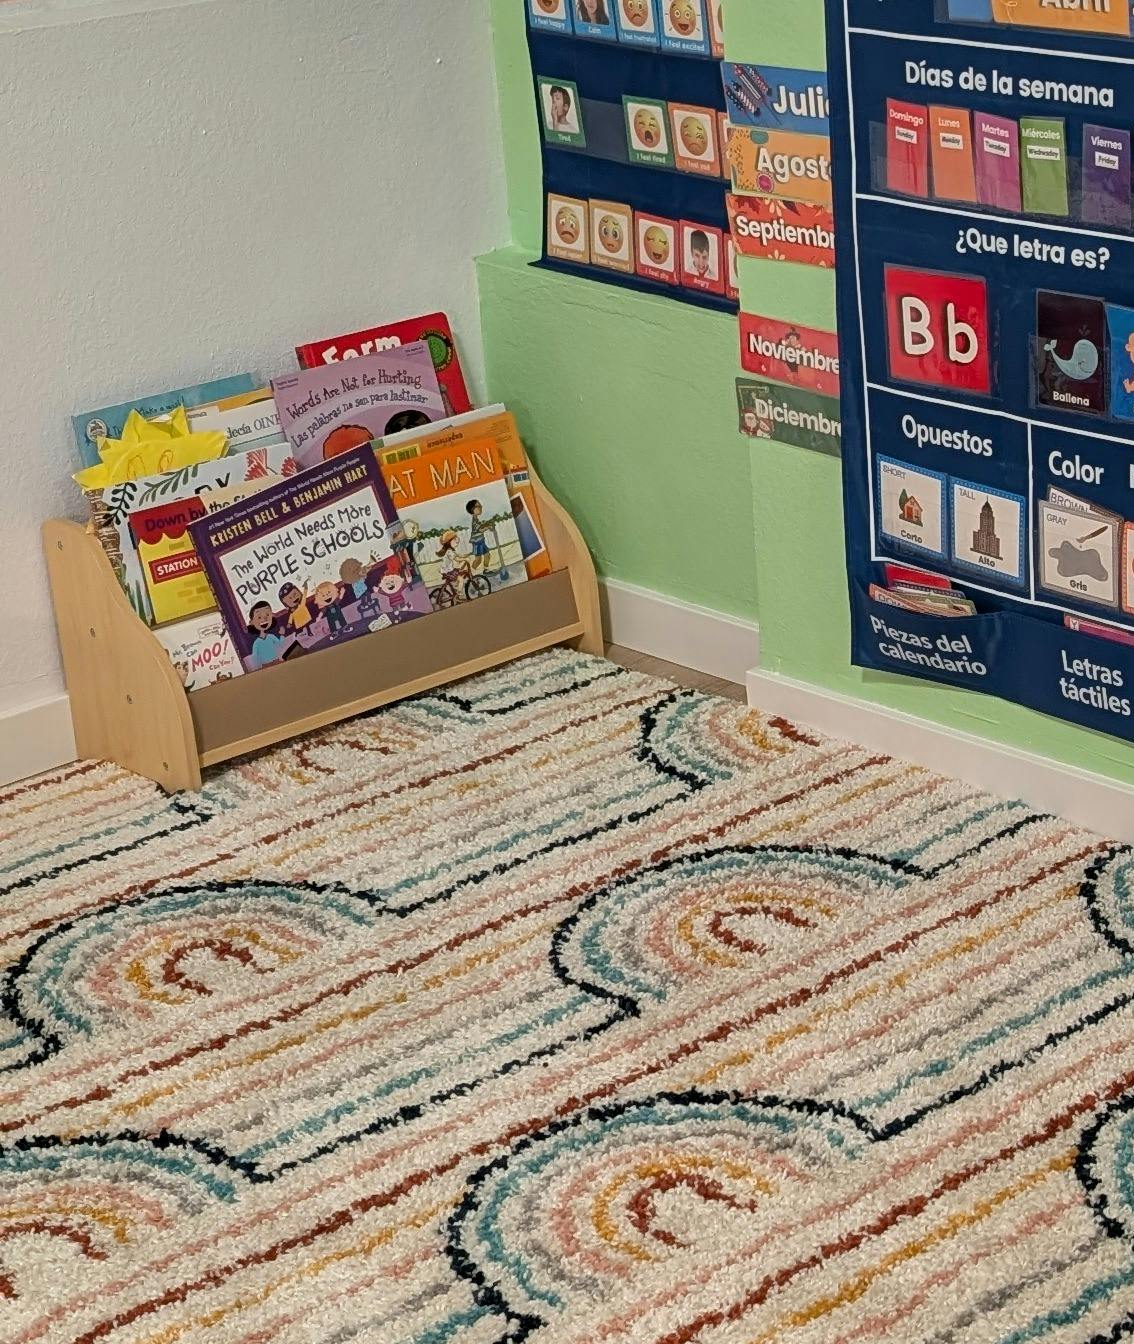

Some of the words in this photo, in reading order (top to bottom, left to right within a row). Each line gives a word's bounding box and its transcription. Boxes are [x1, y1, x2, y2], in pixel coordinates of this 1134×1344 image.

[905, 59, 954, 89] Días
[959, 66, 987, 92] de
[992, 70, 1013, 96] la
[1018, 75, 1114, 107] semana
[773, 85, 829, 119] Juli
[889, 109, 924, 127] Domingo
[938, 117, 961, 128] Lunes
[981, 123, 1009, 138] Martes
[1091, 135, 1123, 151] Viernes
[757, 147, 832, 183] Agost
[955, 227, 1008, 254] ¿Que
[1014, 234, 1065, 264] letra
[1070, 246, 1110, 270] es?
[750, 333, 839, 375] Noviembre
[286, 390, 322, 420] Words
[323, 387, 340, 400] Are
[341, 376, 359, 393] Not
[362, 373, 376, 387] for
[378, 369, 422, 390] Hurting
[1053, 391, 1090, 407] Ballena
[291, 431, 309, 448] Las
[308, 406, 341, 438] palabras
[370, 393, 388, 406] para
[390, 388, 428, 404] lastimar
[901, 414, 993, 457] Opuestos
[429, 447, 495, 492] MAN
[882, 464, 907, 480] SHORT
[1048, 450, 1104, 485] Color
[210, 520, 252, 548] KRISTEN
[255, 508, 279, 526] BELL
[281, 501, 291, 514] &
[292, 477, 342, 508] BENJAMIN
[344, 464, 368, 483] HART
[959, 487, 976, 500] TALL
[144, 513, 186, 533] Down
[900, 529, 923, 544] Corto
[1047, 513, 1067, 526] GRAY
[231, 559, 254, 579] The
[253, 531, 294, 564] World
[294, 513, 336, 540] Needs
[337, 504, 371, 524] More
[156, 557, 198, 577] STATION
[235, 553, 299, 605] PURPLE
[301, 519, 385, 566] SCHOOLS
[978, 555, 995, 567] Alto
[870, 614, 933, 649] Piezas
[936, 634, 973, 654] del
[191, 638, 229, 673] MOO!
[879, 642, 987, 676] calendario
[1061, 649, 1124, 687] Letras
[1059, 676, 1131, 716] táctiles
